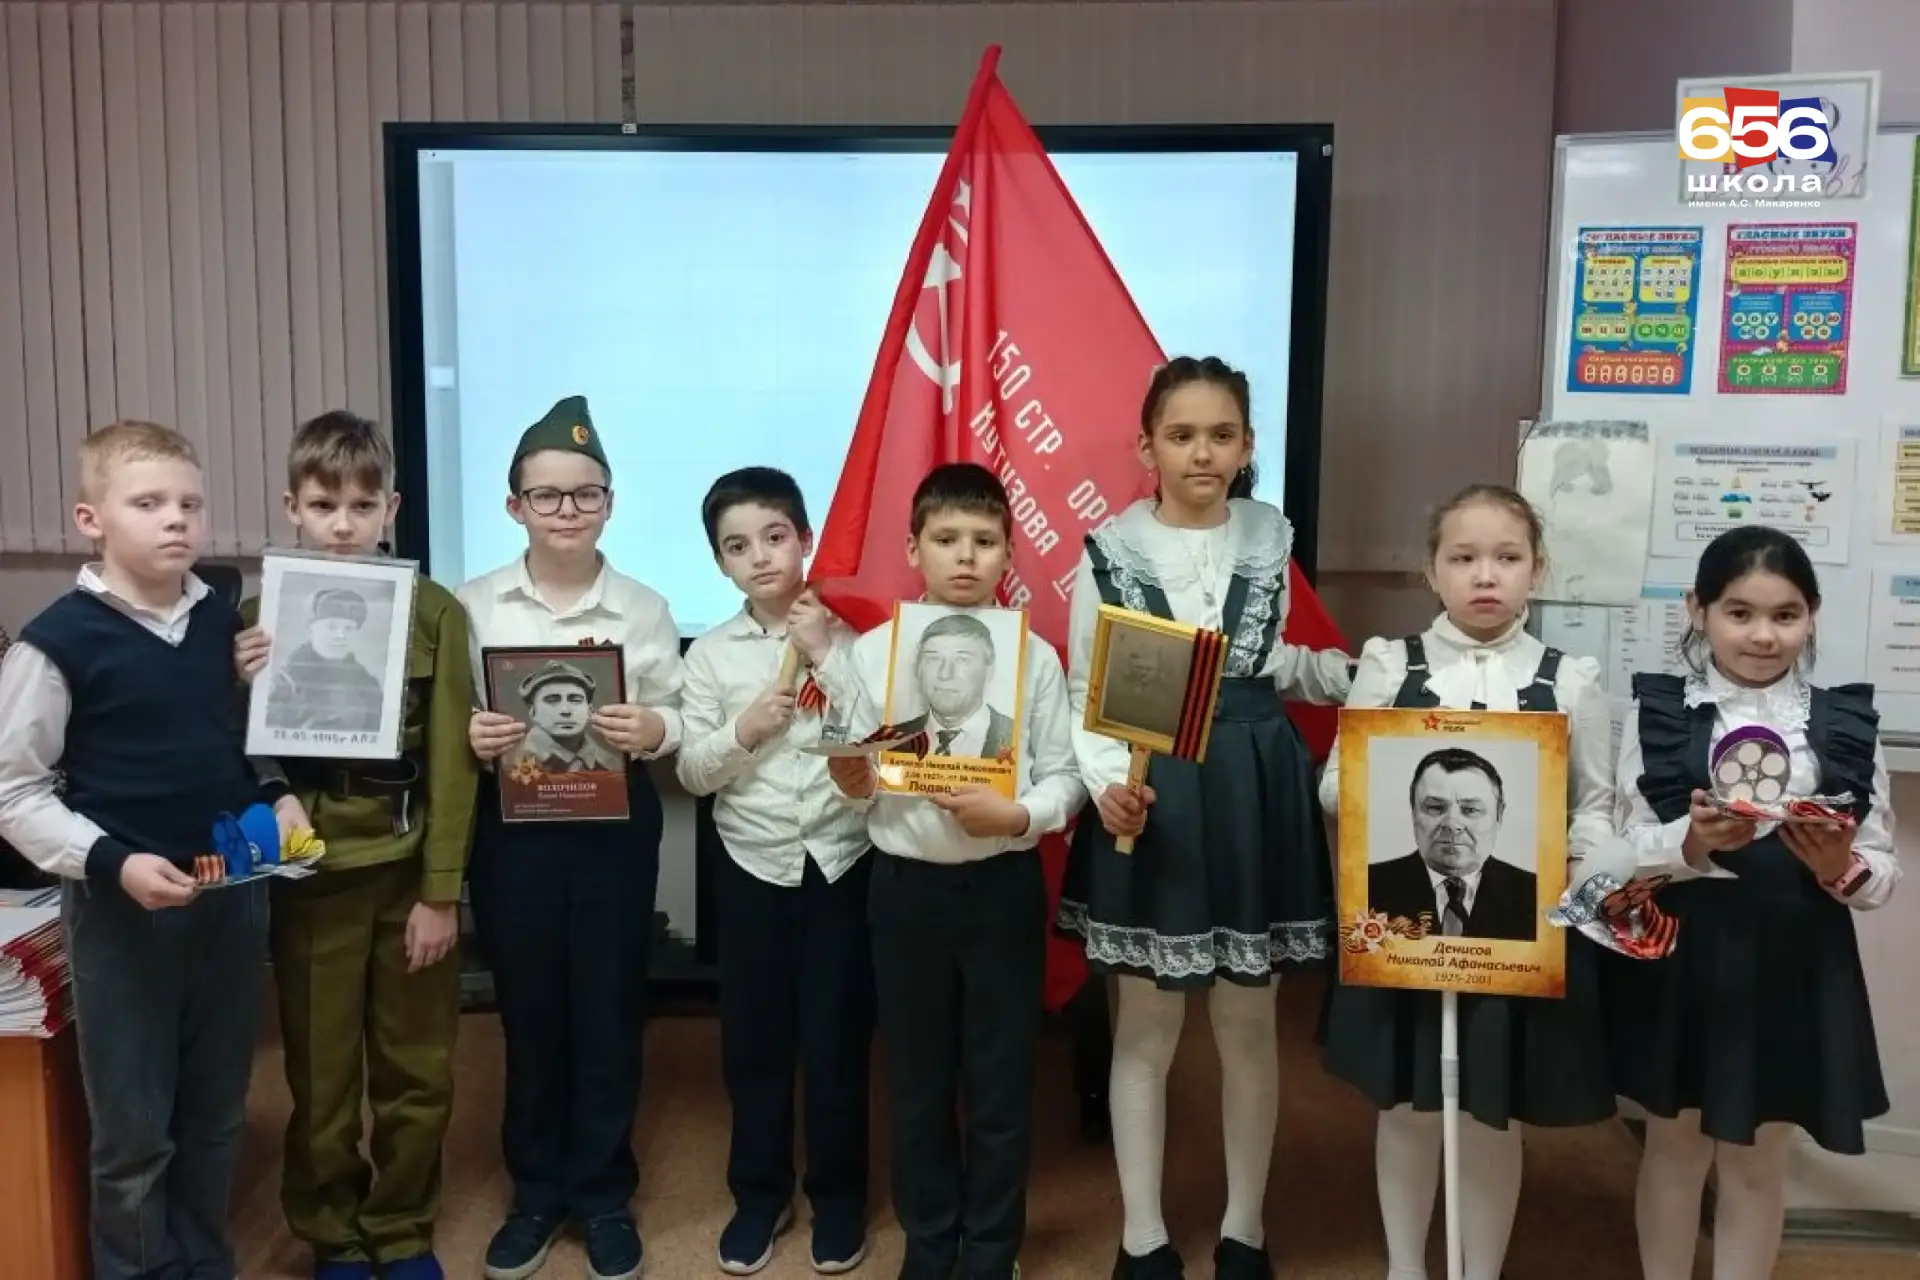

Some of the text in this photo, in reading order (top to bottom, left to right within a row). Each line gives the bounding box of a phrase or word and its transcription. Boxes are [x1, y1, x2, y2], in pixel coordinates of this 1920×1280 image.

[987, 330, 1032, 401] 150
[1014, 399, 1063, 471] СТР.
[1432, 942, 1493, 956] Денисов
[1386, 953, 1541, 973] Николай Афанасьевич
[1434, 972, 1493, 985] 1925-2001
